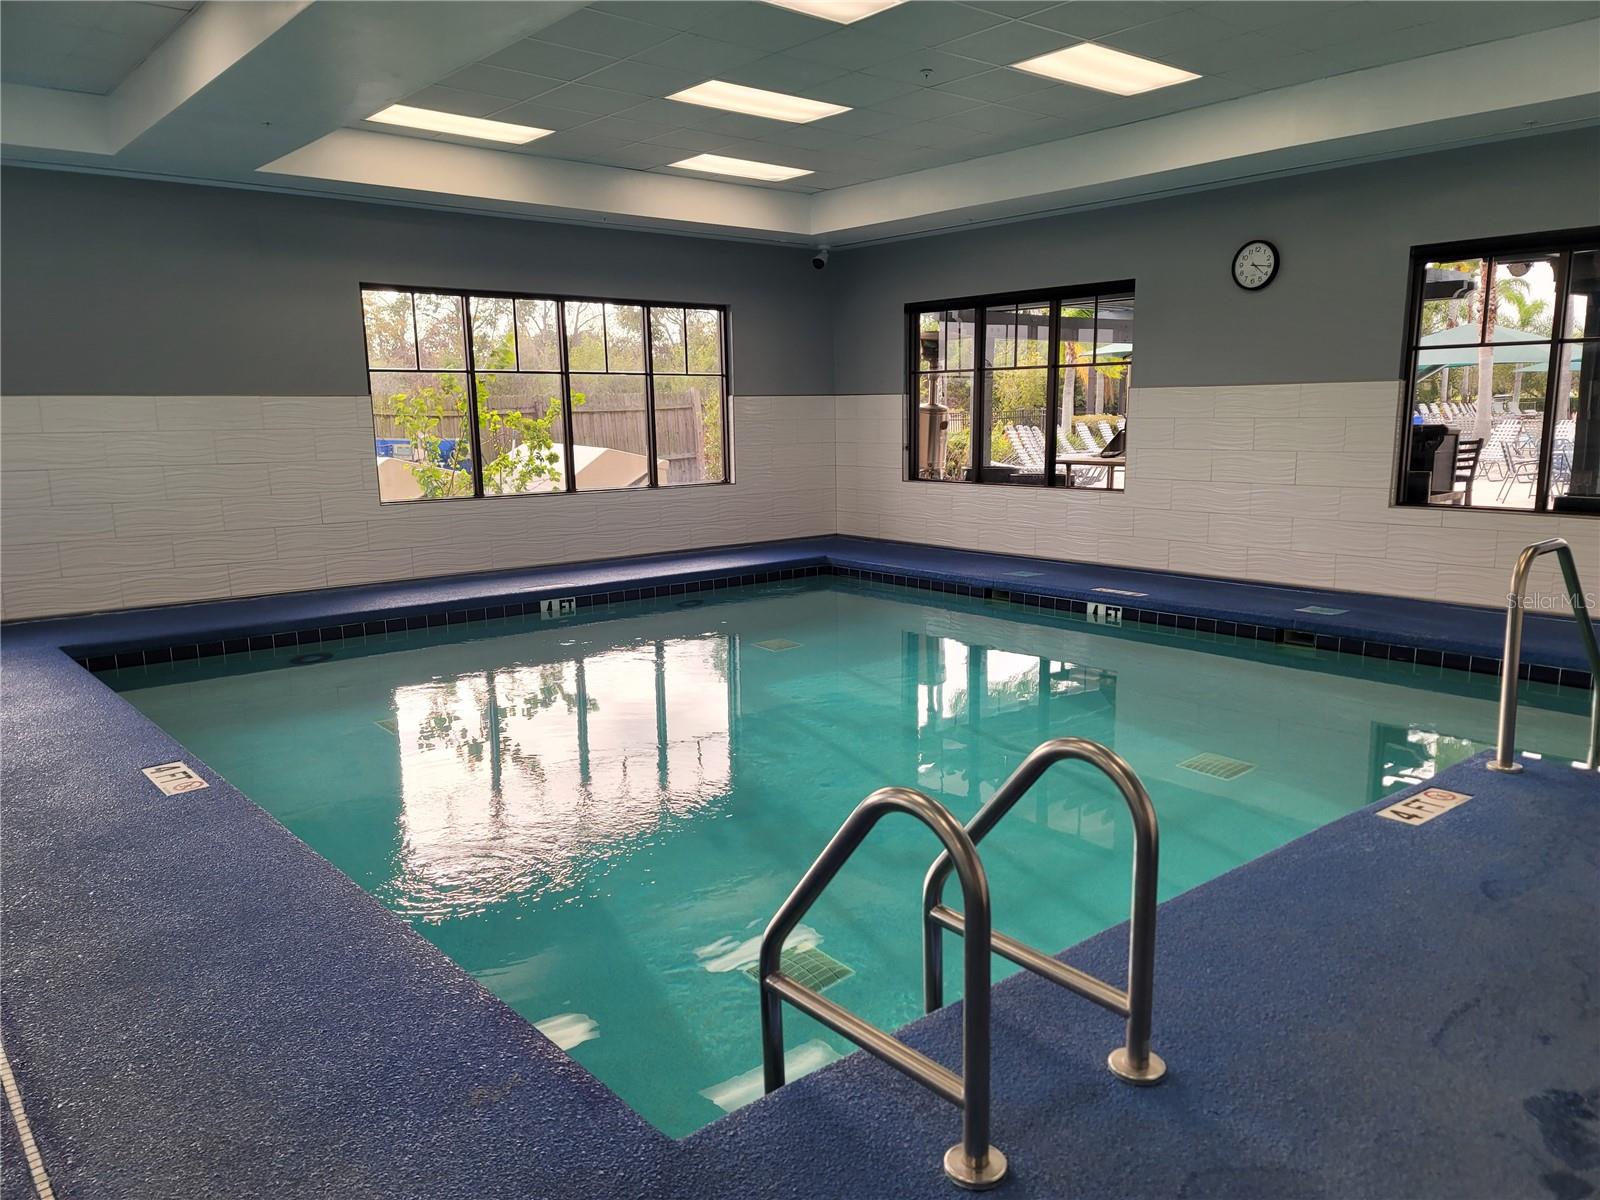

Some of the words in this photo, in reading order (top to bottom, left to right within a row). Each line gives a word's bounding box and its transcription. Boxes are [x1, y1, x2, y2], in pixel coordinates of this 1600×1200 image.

[559, 598, 575, 611] FT
[1105, 605, 1121, 618] FT
[1402, 798, 1446, 814] FT
[1390, 809, 1424, 820] 4
